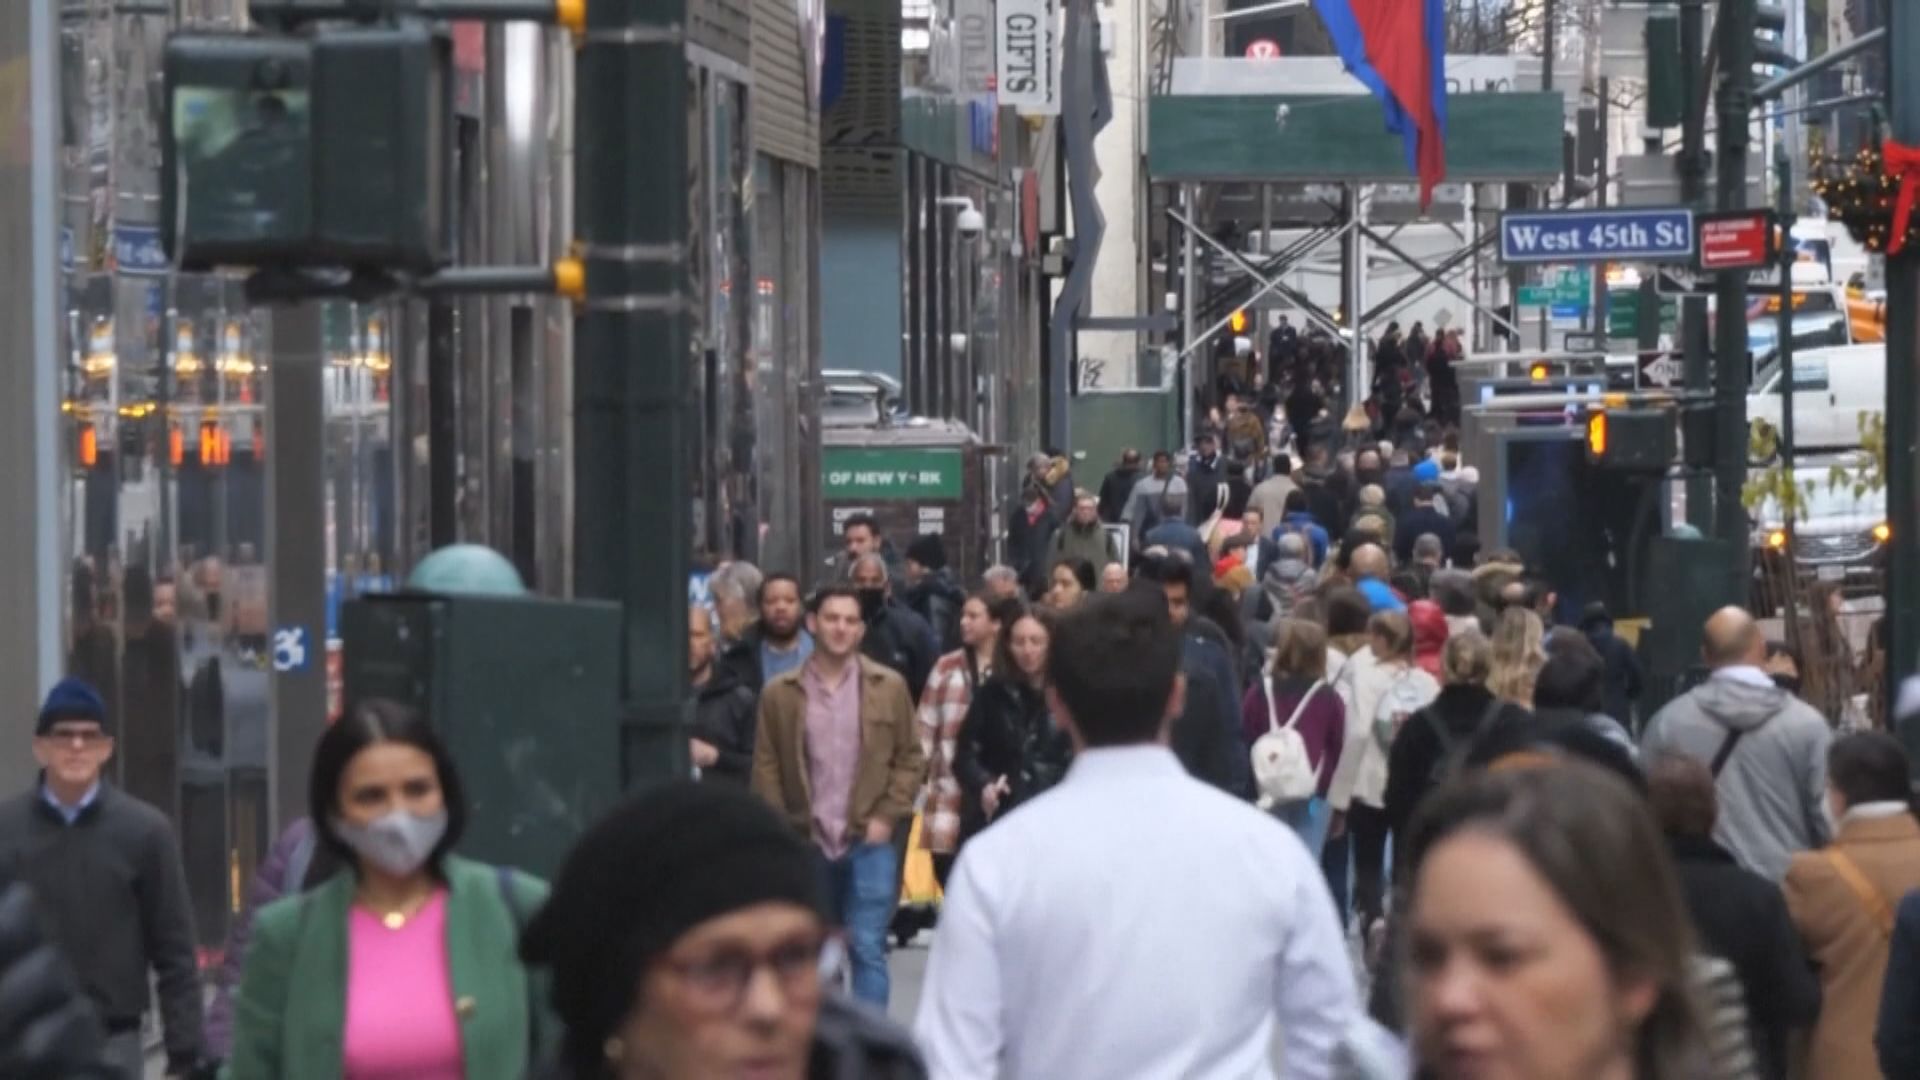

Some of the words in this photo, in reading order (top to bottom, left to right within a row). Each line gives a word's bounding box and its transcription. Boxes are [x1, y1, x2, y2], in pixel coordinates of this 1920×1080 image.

[1006, 13, 1038, 94] GIFTS
[1509, 225, 1582, 252] West
[1587, 221, 1648, 248] 45th
[1655, 220, 1685, 248] St
[829, 471, 852, 486] OF
[855, 471, 893, 486] NEW
